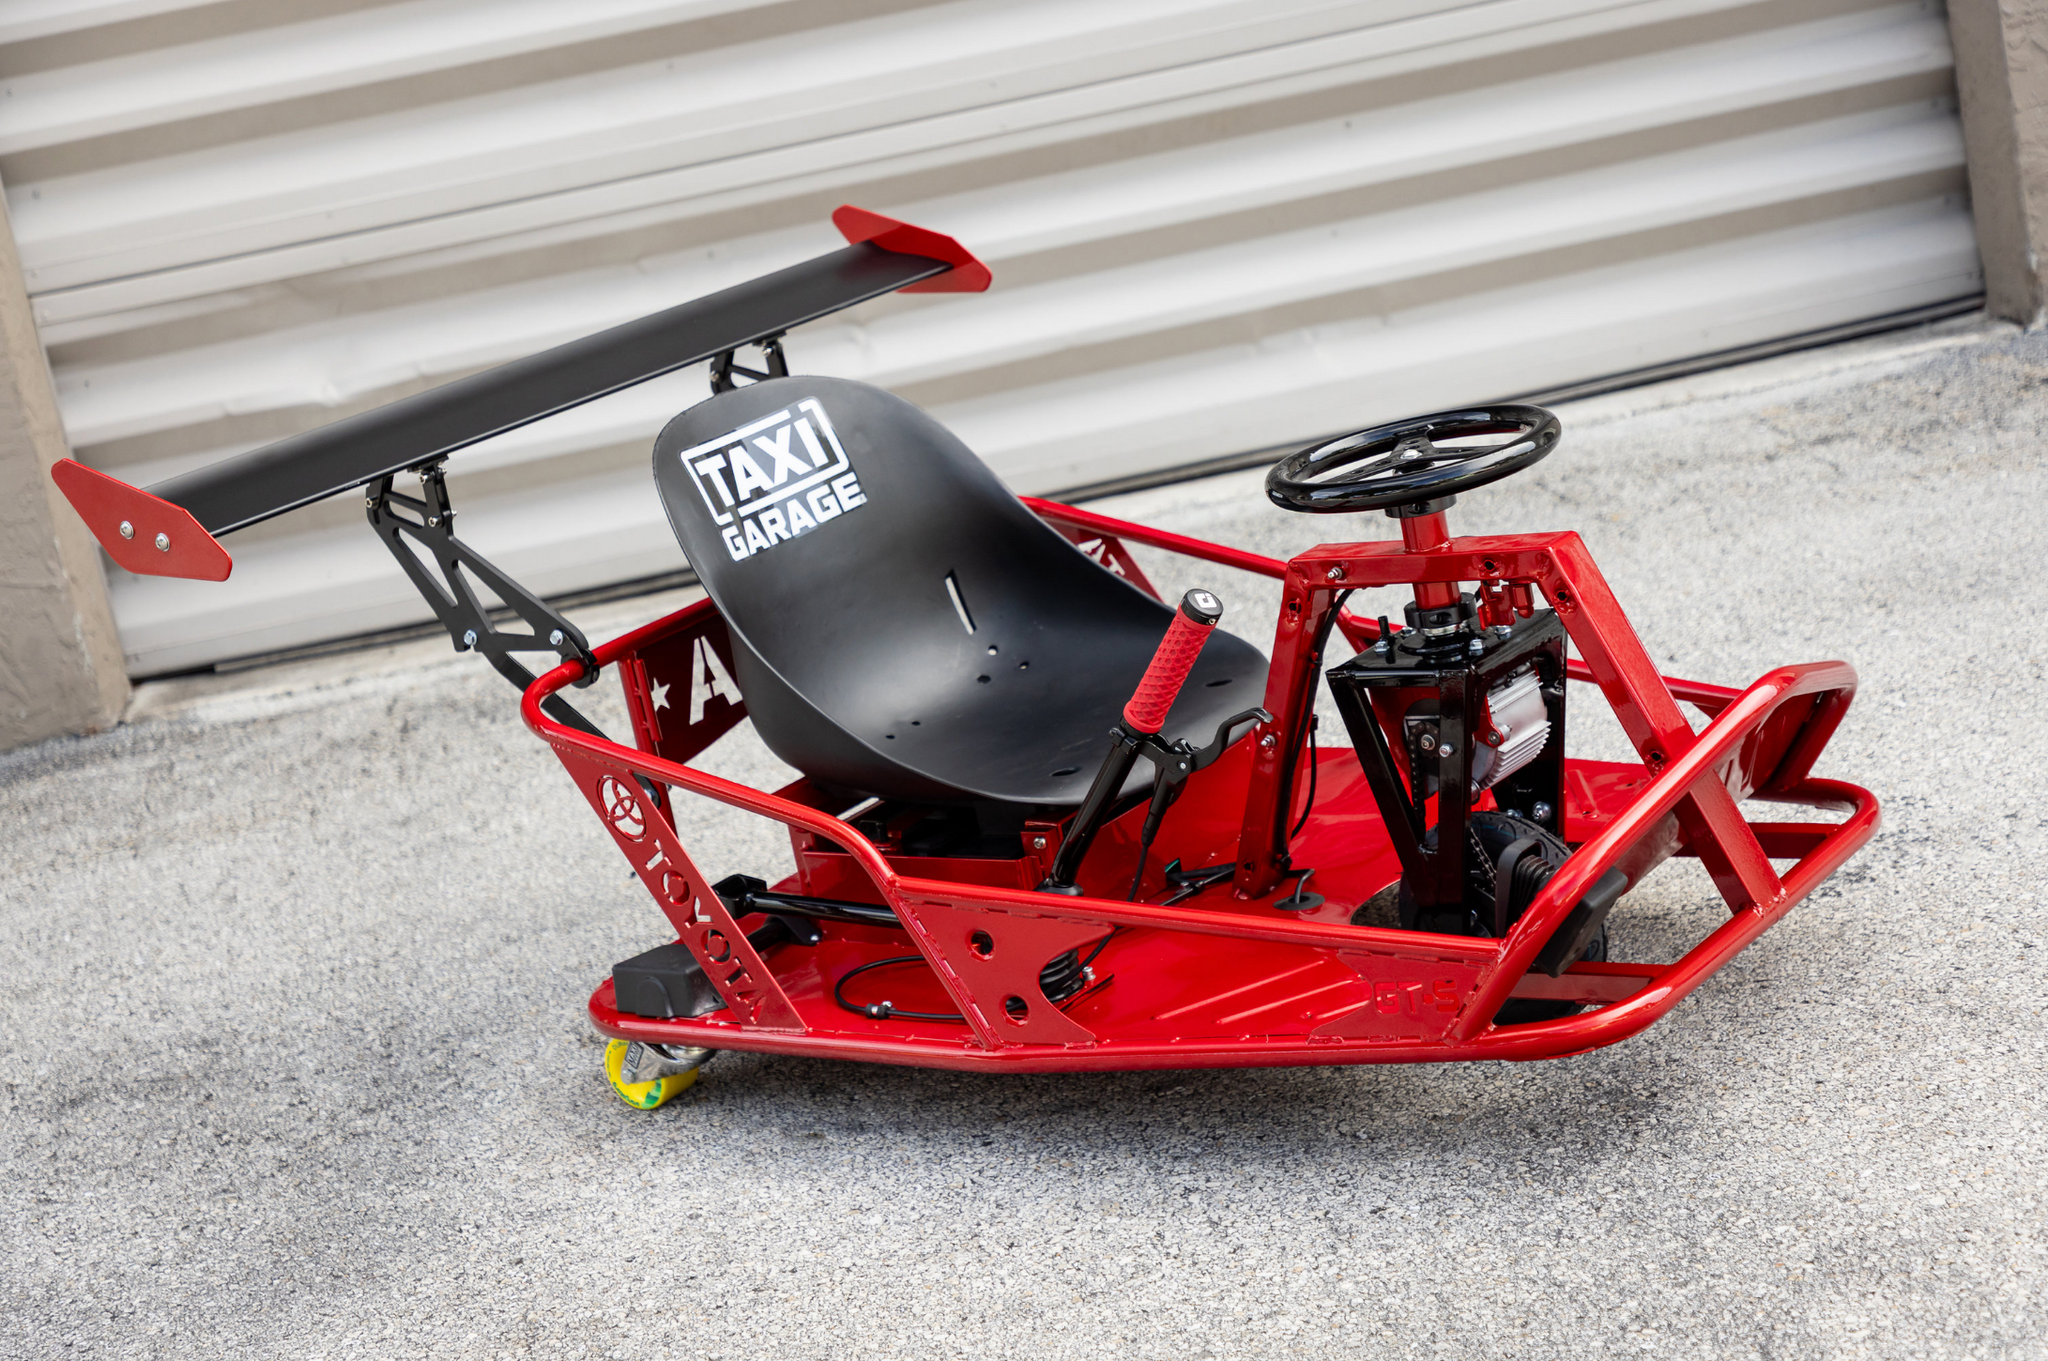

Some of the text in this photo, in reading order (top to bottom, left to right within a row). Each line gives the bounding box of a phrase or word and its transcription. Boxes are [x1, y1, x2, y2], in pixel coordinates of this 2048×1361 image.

[694, 417, 829, 507] TAXI
[722, 472, 867, 562] GARAGE
[645, 839, 765, 1024] TOYOTA
